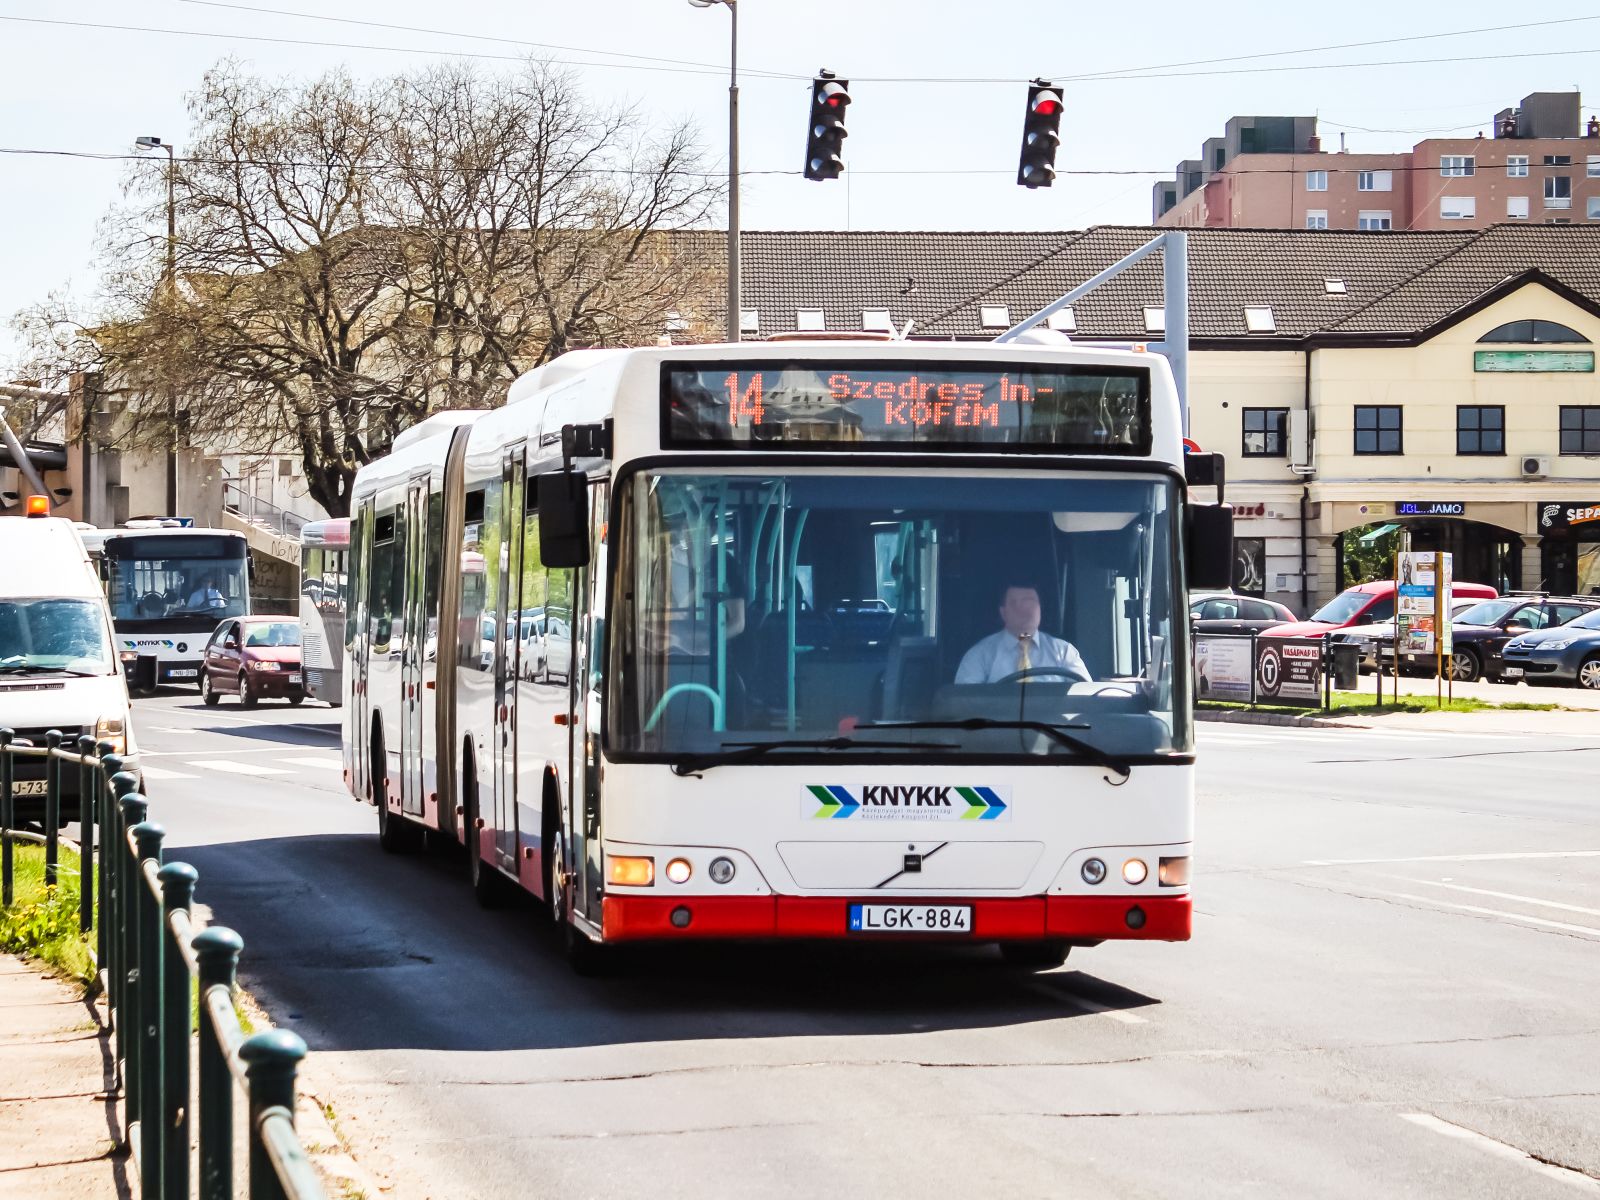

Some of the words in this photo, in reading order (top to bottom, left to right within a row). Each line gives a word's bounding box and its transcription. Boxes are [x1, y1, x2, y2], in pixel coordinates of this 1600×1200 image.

[724, 372, 764, 425] 14
[828, 374, 984, 400] Szedres
[863, 786, 952, 806] KNYKK
[867, 908, 965, 928] LGK-884
